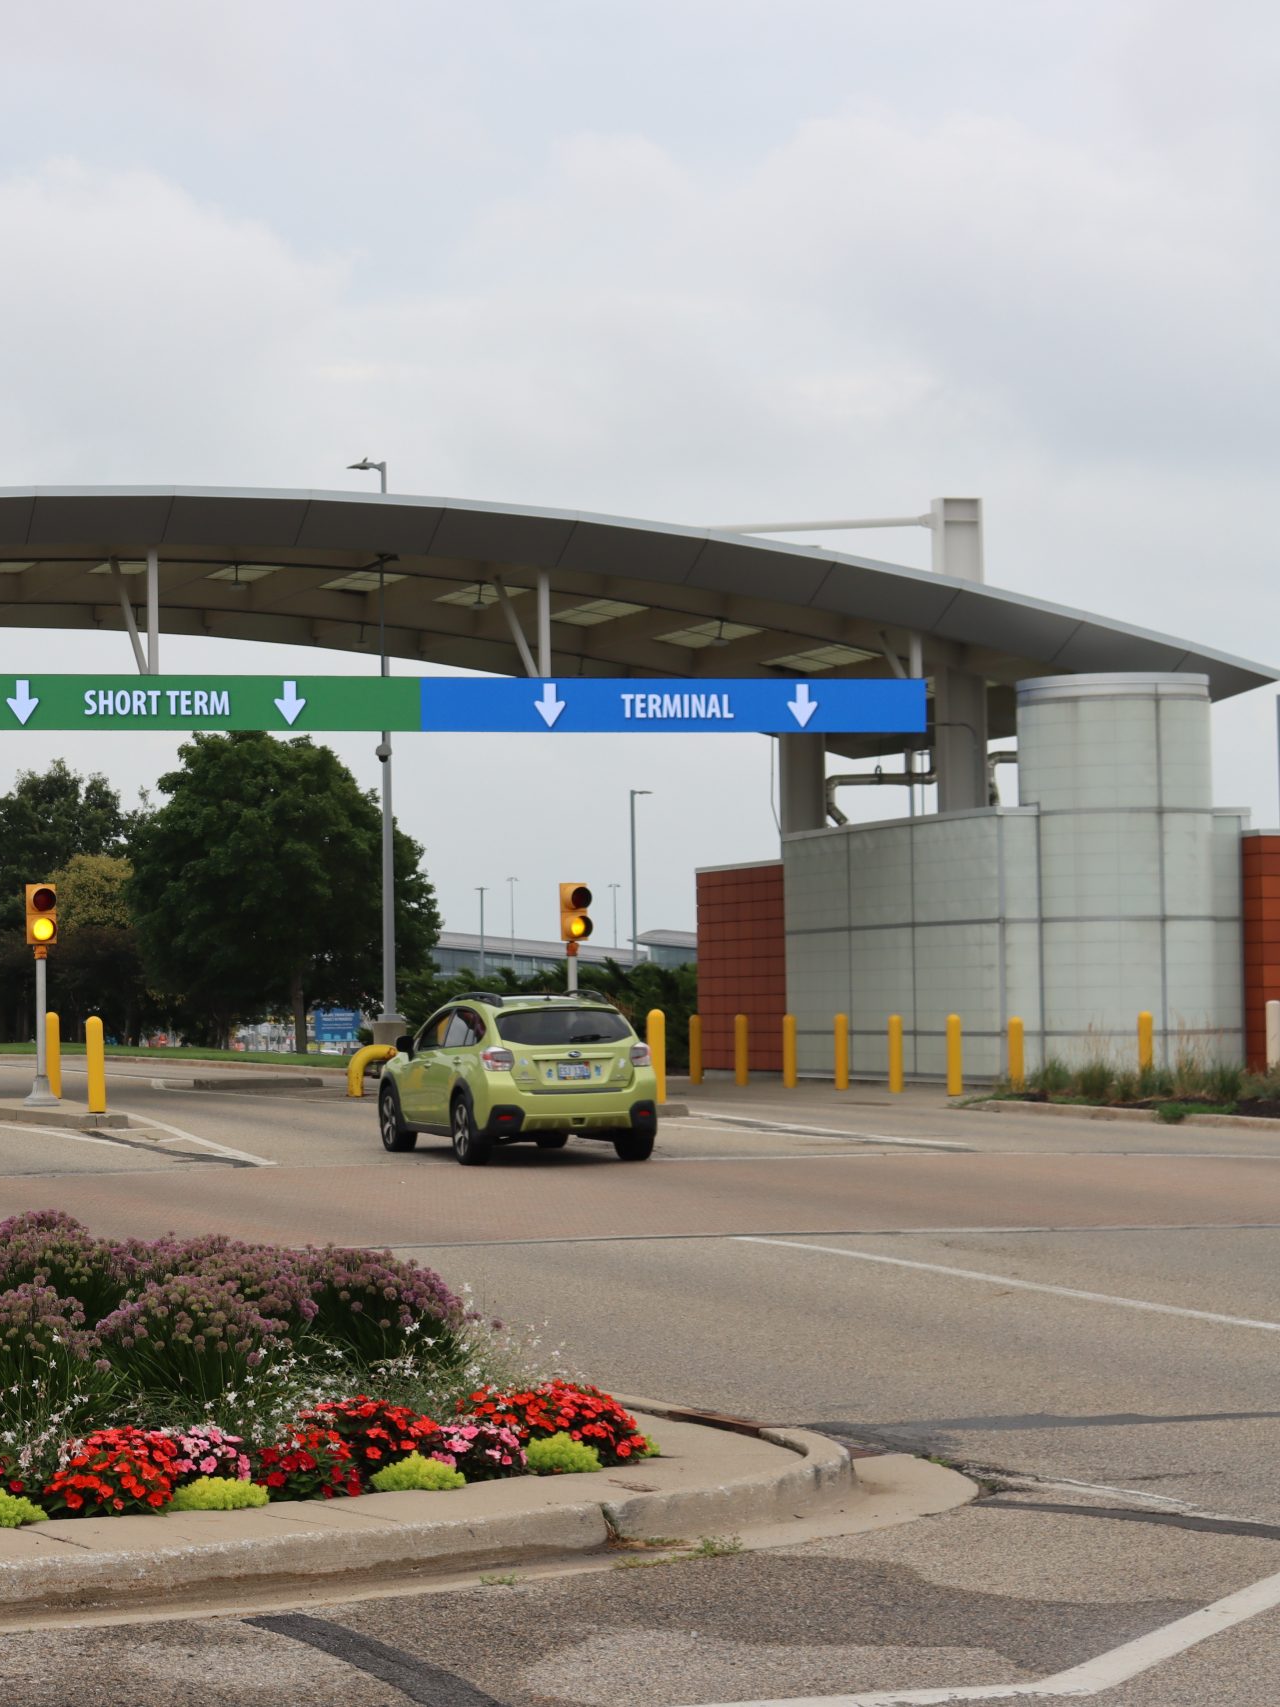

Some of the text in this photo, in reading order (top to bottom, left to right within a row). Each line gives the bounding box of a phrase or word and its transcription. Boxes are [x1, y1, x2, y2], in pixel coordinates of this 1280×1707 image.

[84, 690, 230, 716] SHORT TERM
[621, 693, 734, 719] TERMINAL
